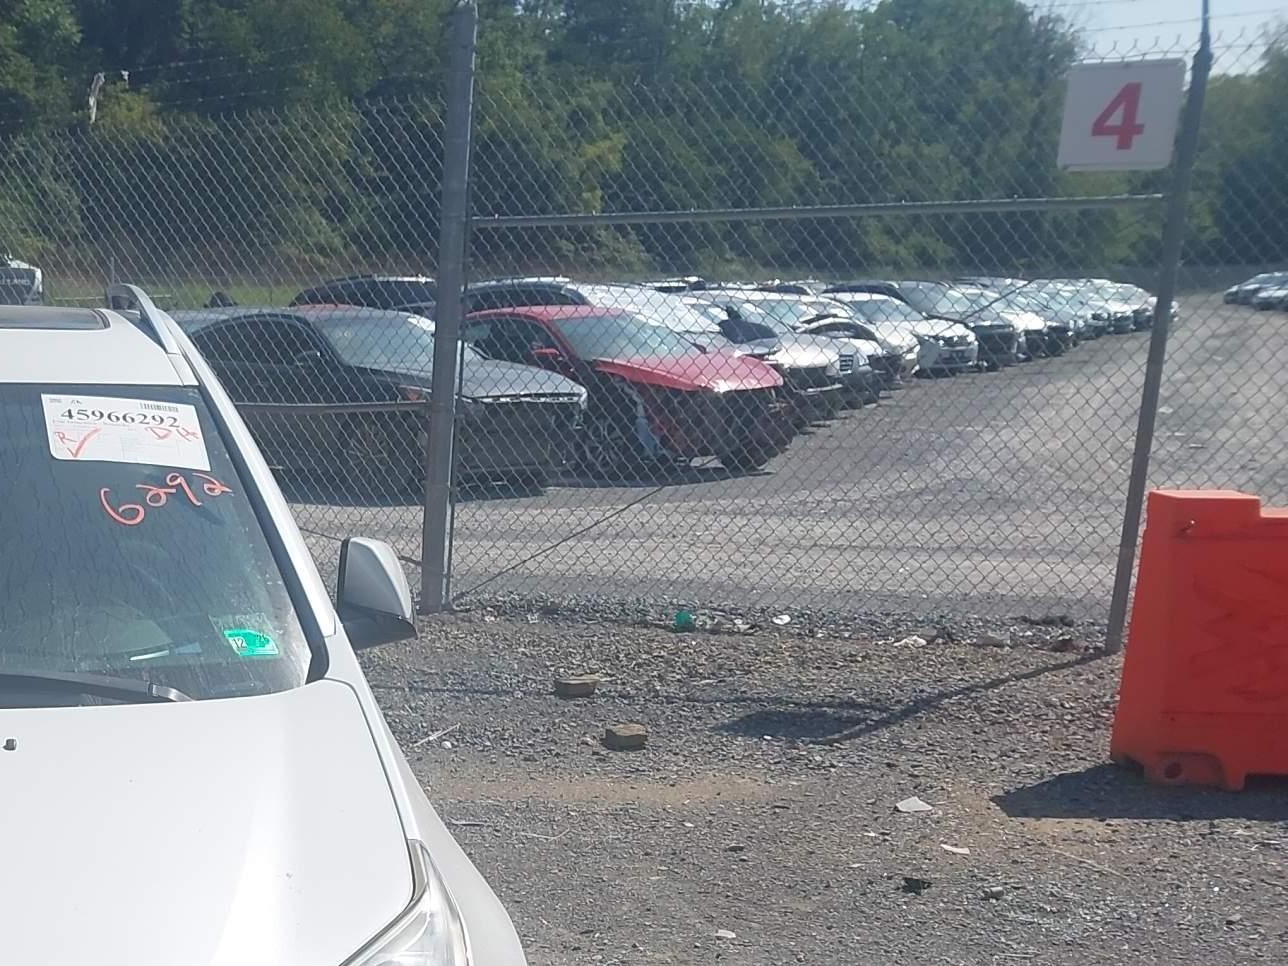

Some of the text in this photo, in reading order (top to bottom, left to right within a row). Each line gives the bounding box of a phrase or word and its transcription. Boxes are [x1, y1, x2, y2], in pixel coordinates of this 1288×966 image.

[1090, 81, 1145, 150] 4
[60, 407, 181, 429] 45966292
[99, 472, 233, 526] 6292
[233, 638, 248, 649] 12
